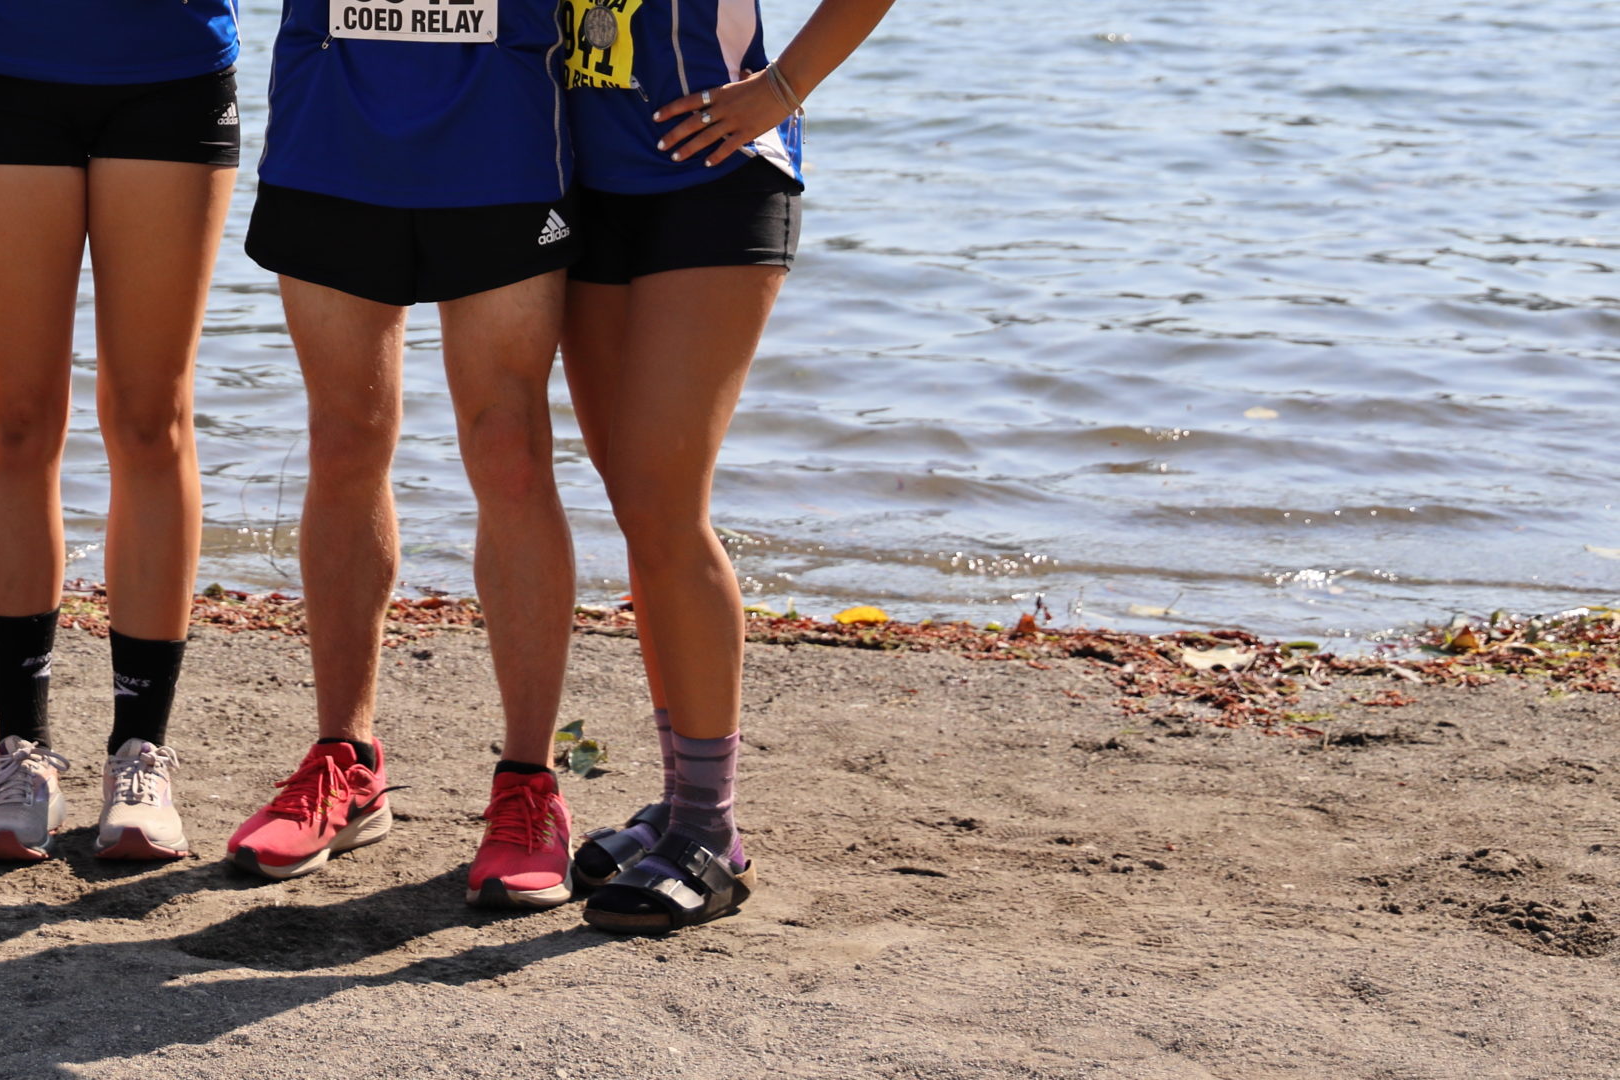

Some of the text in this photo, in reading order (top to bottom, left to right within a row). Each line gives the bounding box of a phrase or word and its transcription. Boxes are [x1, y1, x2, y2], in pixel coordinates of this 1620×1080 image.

[343, 6, 484, 34] COED RELAY
[573, 69, 620, 88] REL
[538, 227, 570, 245] adidas
